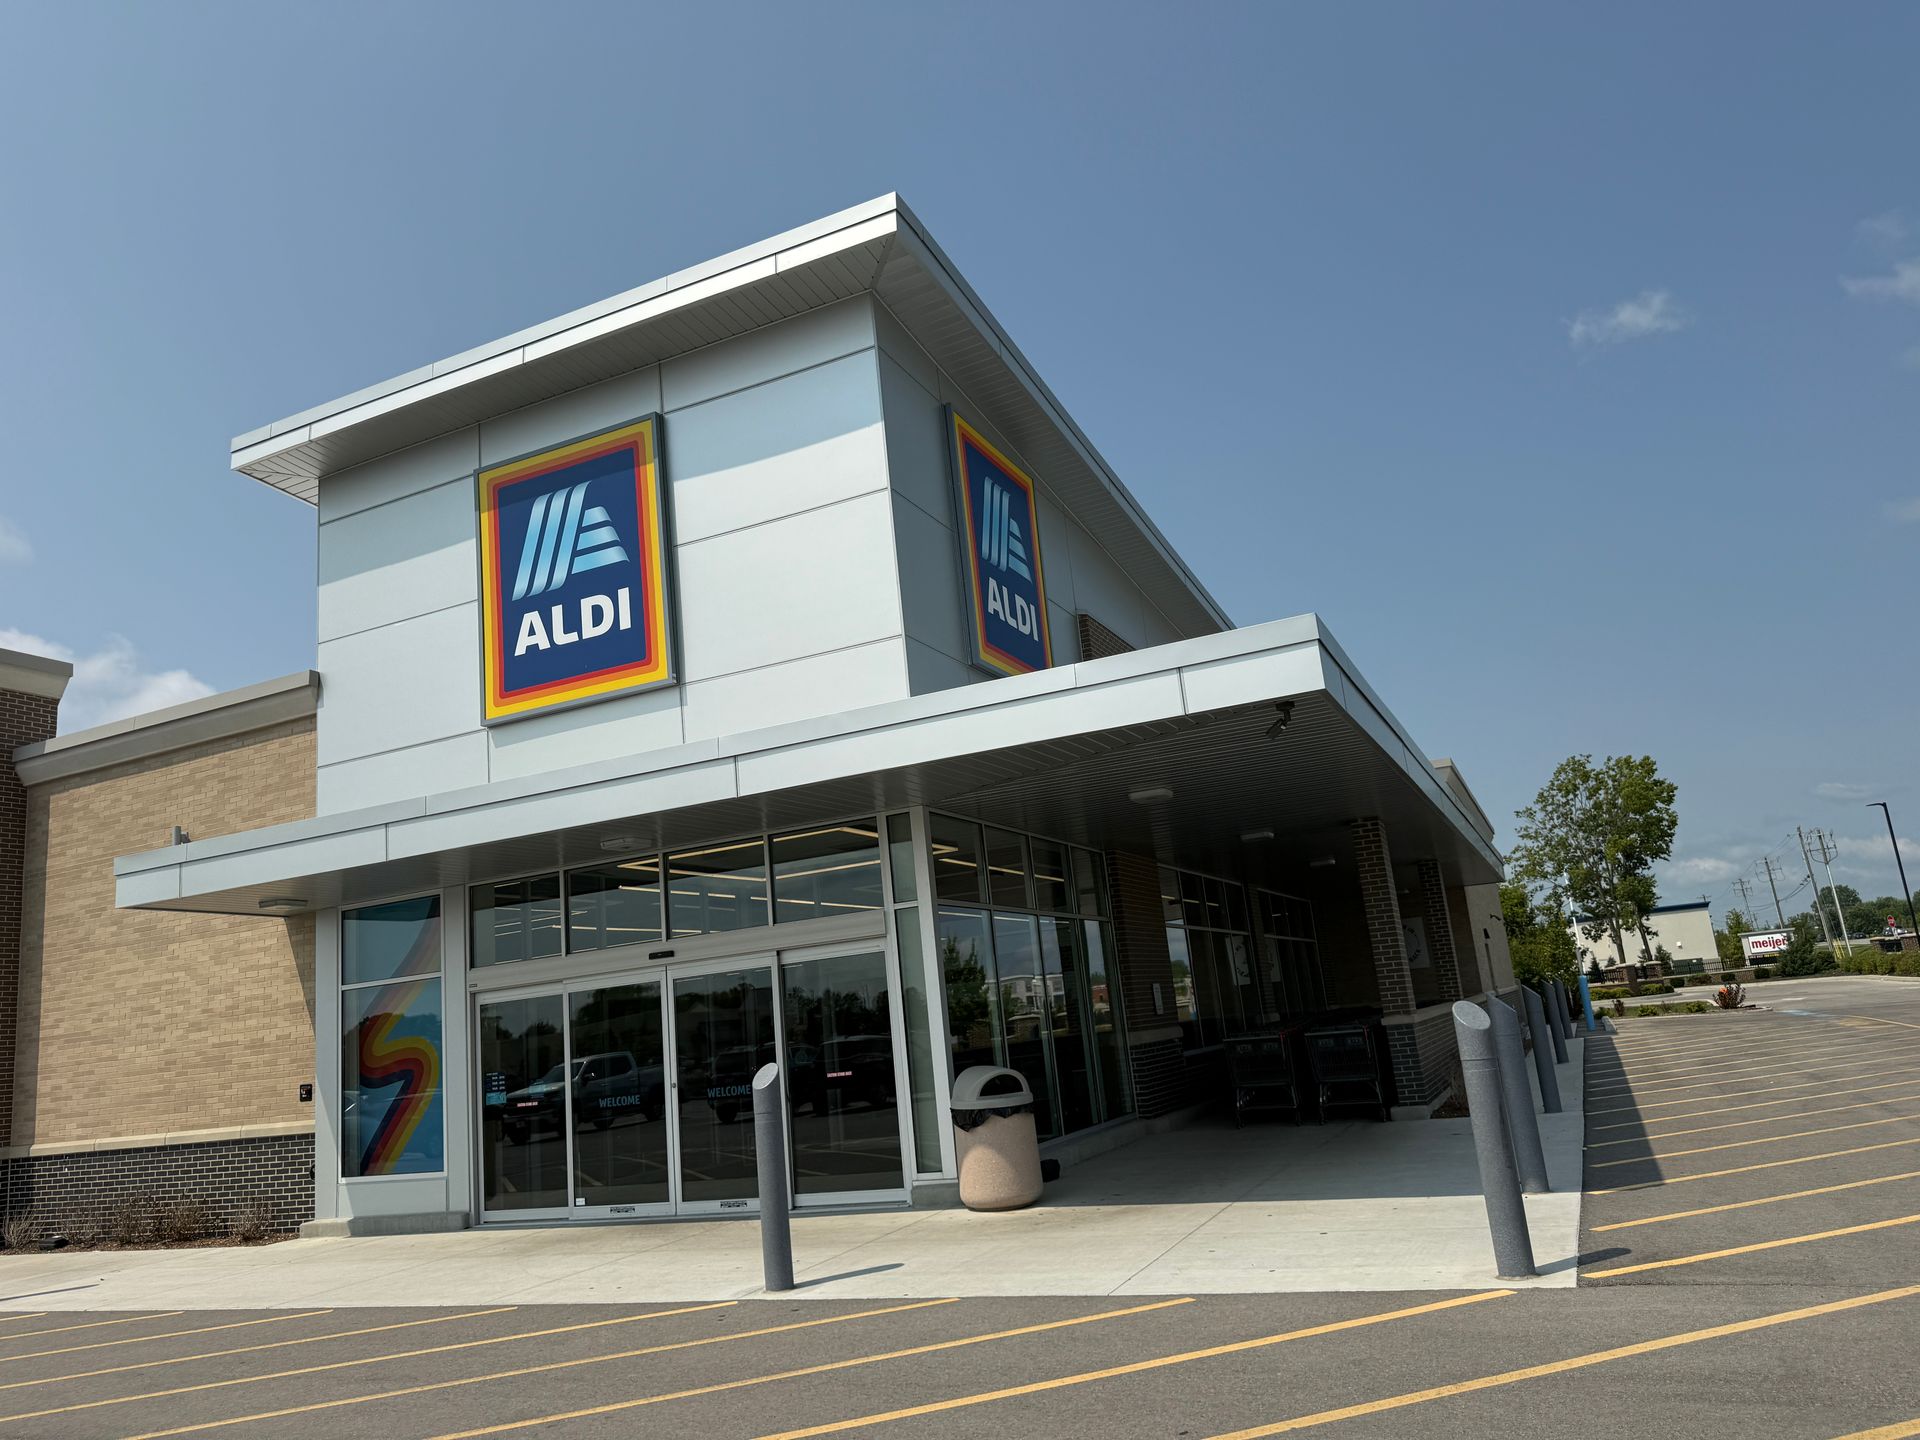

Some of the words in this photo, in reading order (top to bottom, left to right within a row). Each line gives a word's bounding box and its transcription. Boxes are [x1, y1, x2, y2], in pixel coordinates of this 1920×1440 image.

[988, 577, 1039, 641] ALDI
[514, 587, 631, 656] ALDI
[1751, 937, 1787, 949] meijer
[707, 1084, 752, 1098] WELCOME
[598, 1094, 641, 1108] WELCOME
